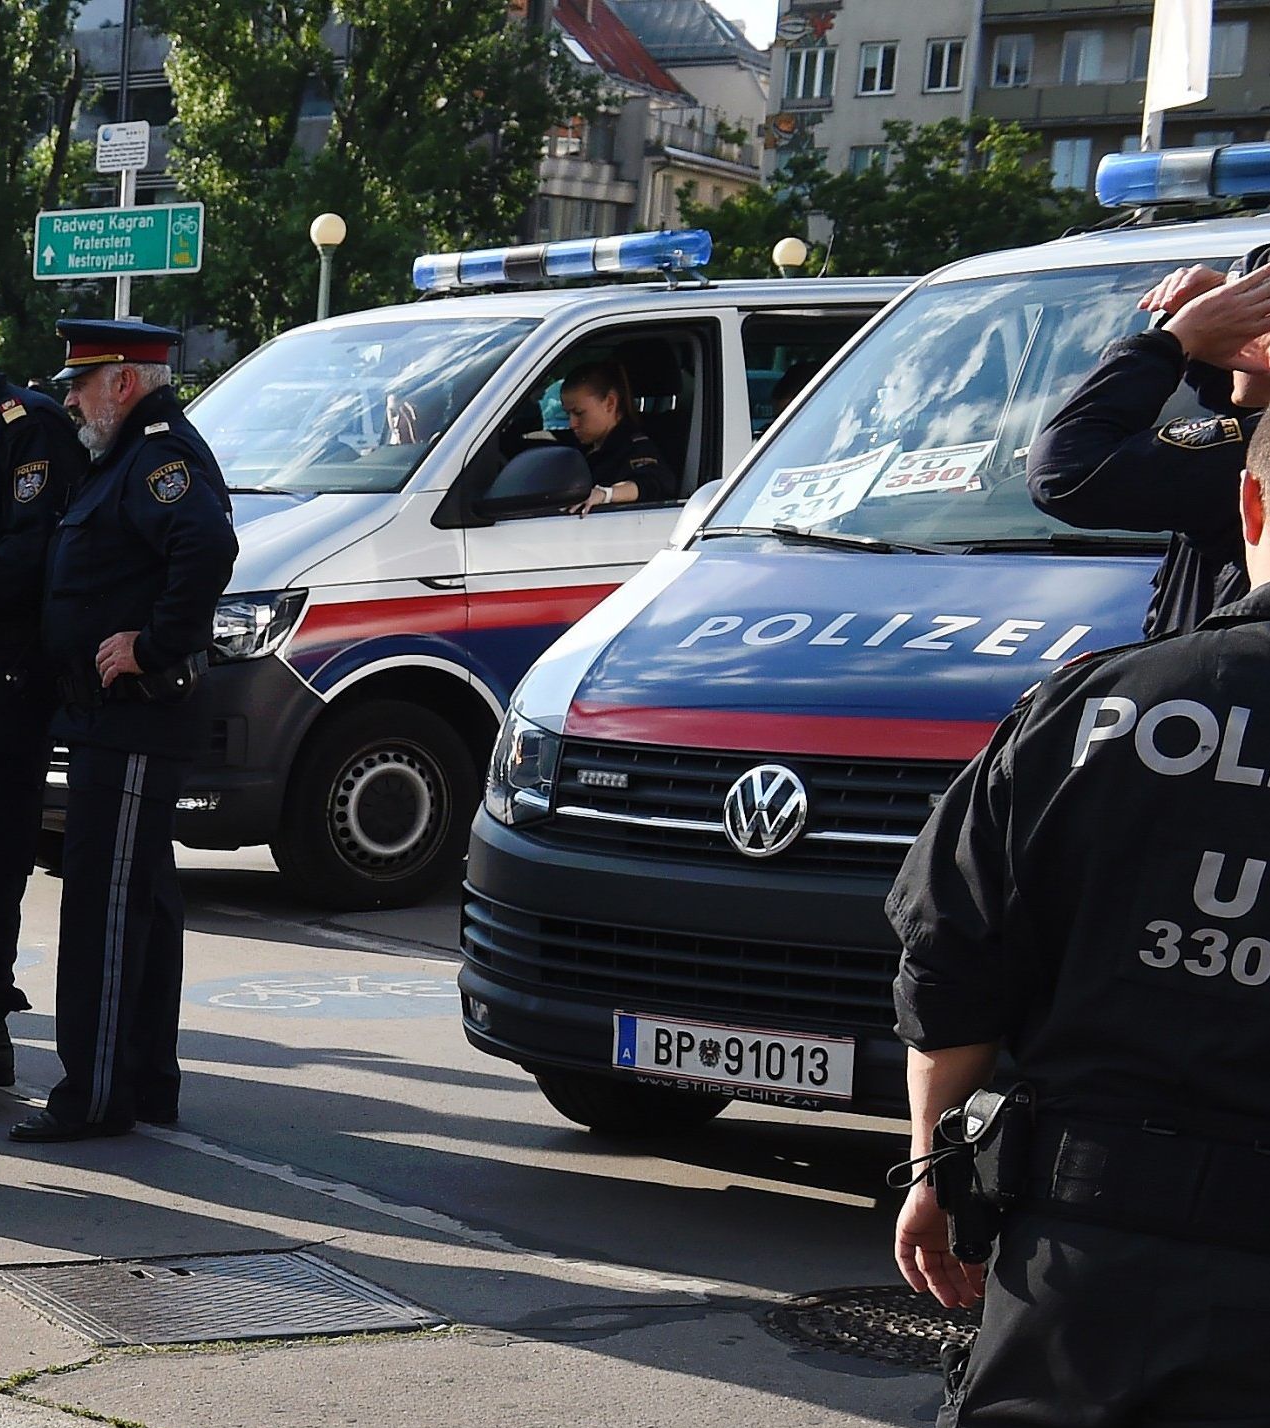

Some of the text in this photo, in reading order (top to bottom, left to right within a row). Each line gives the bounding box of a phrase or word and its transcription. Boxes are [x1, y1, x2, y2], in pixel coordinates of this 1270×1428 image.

[53, 214, 154, 234] Radweg Kagran
[73, 235, 132, 250] Praterstern
[68, 252, 135, 269] Nestroyplatz
[17, 464, 45, 475] POLIZEI
[149, 464, 182, 481] POLIZEI
[885, 466, 967, 489] 330
[678, 612, 1094, 661] POLIZEI
[1071, 696, 1270, 788] POL
[1192, 850, 1268, 919] U
[1138, 920, 1270, 988] 330
[622, 1048, 631, 1060] A
[654, 1027, 829, 1087] BP 91013
